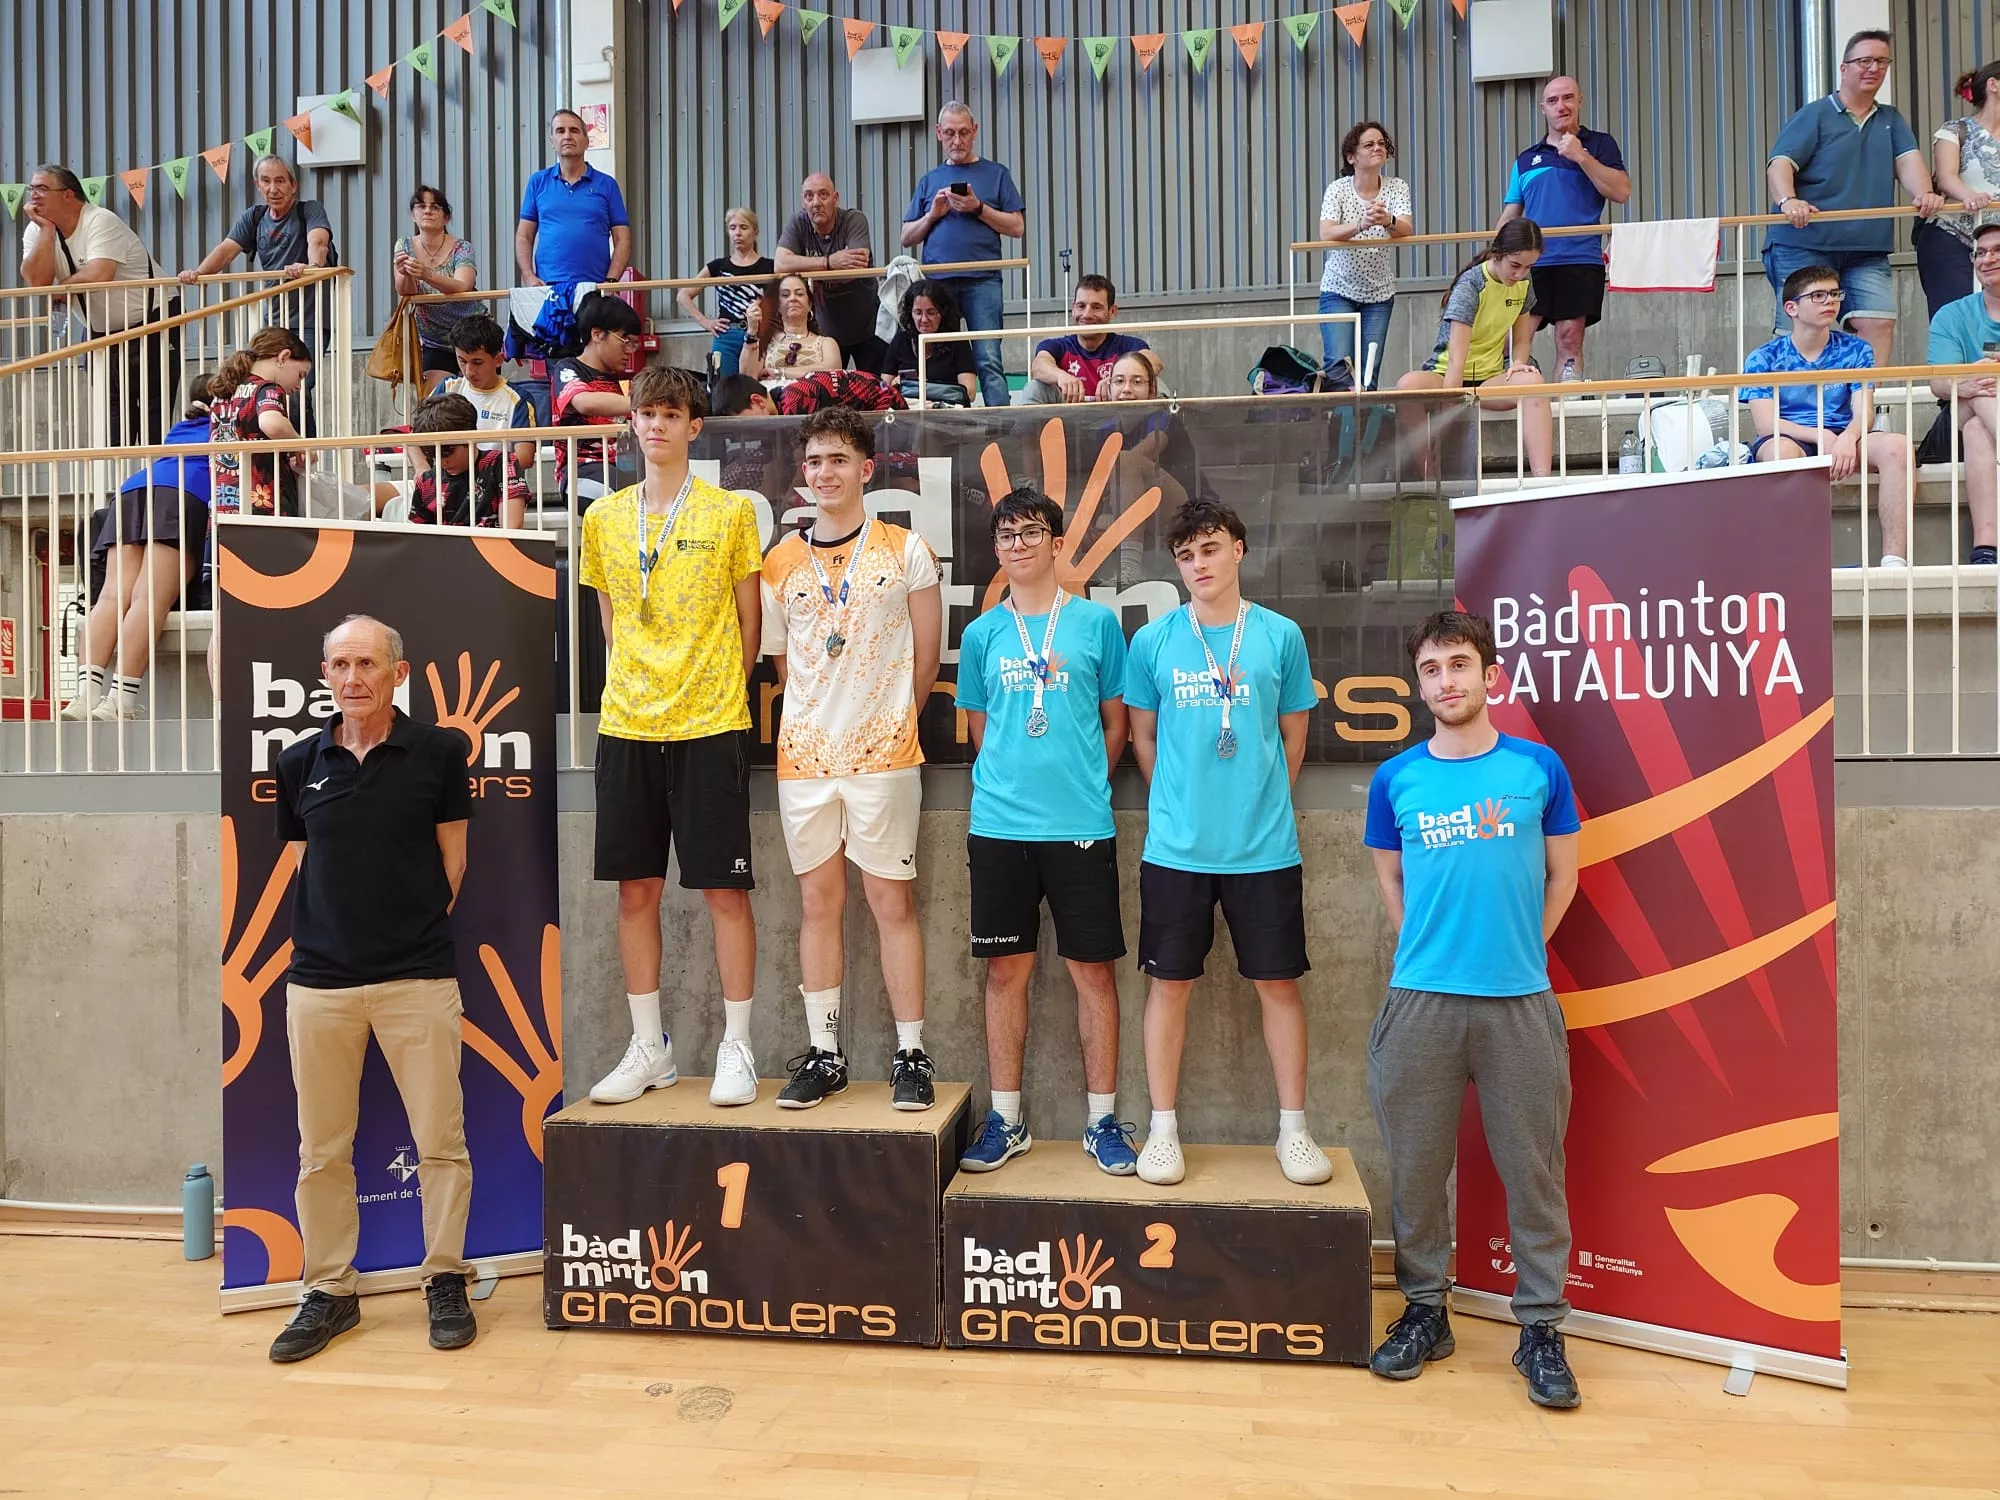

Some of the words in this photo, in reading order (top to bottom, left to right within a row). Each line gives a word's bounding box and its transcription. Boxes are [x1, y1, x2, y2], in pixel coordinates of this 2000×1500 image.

[1493, 580, 1787, 648] Bàdminton
[1417, 805, 1472, 830] bàd
[356, 1190, 397, 1204] tament
[400, 1188, 413, 1199] de
[716, 1162, 750, 1229] 1
[562, 1223, 641, 1260] bàd
[963, 1237, 1051, 1275] bàd
[1139, 1222, 1177, 1269] 2
[1595, 1254, 1636, 1268] Generalitat
[1595, 1262, 1605, 1270] de
[1606, 1263, 1643, 1276] Catalunya
